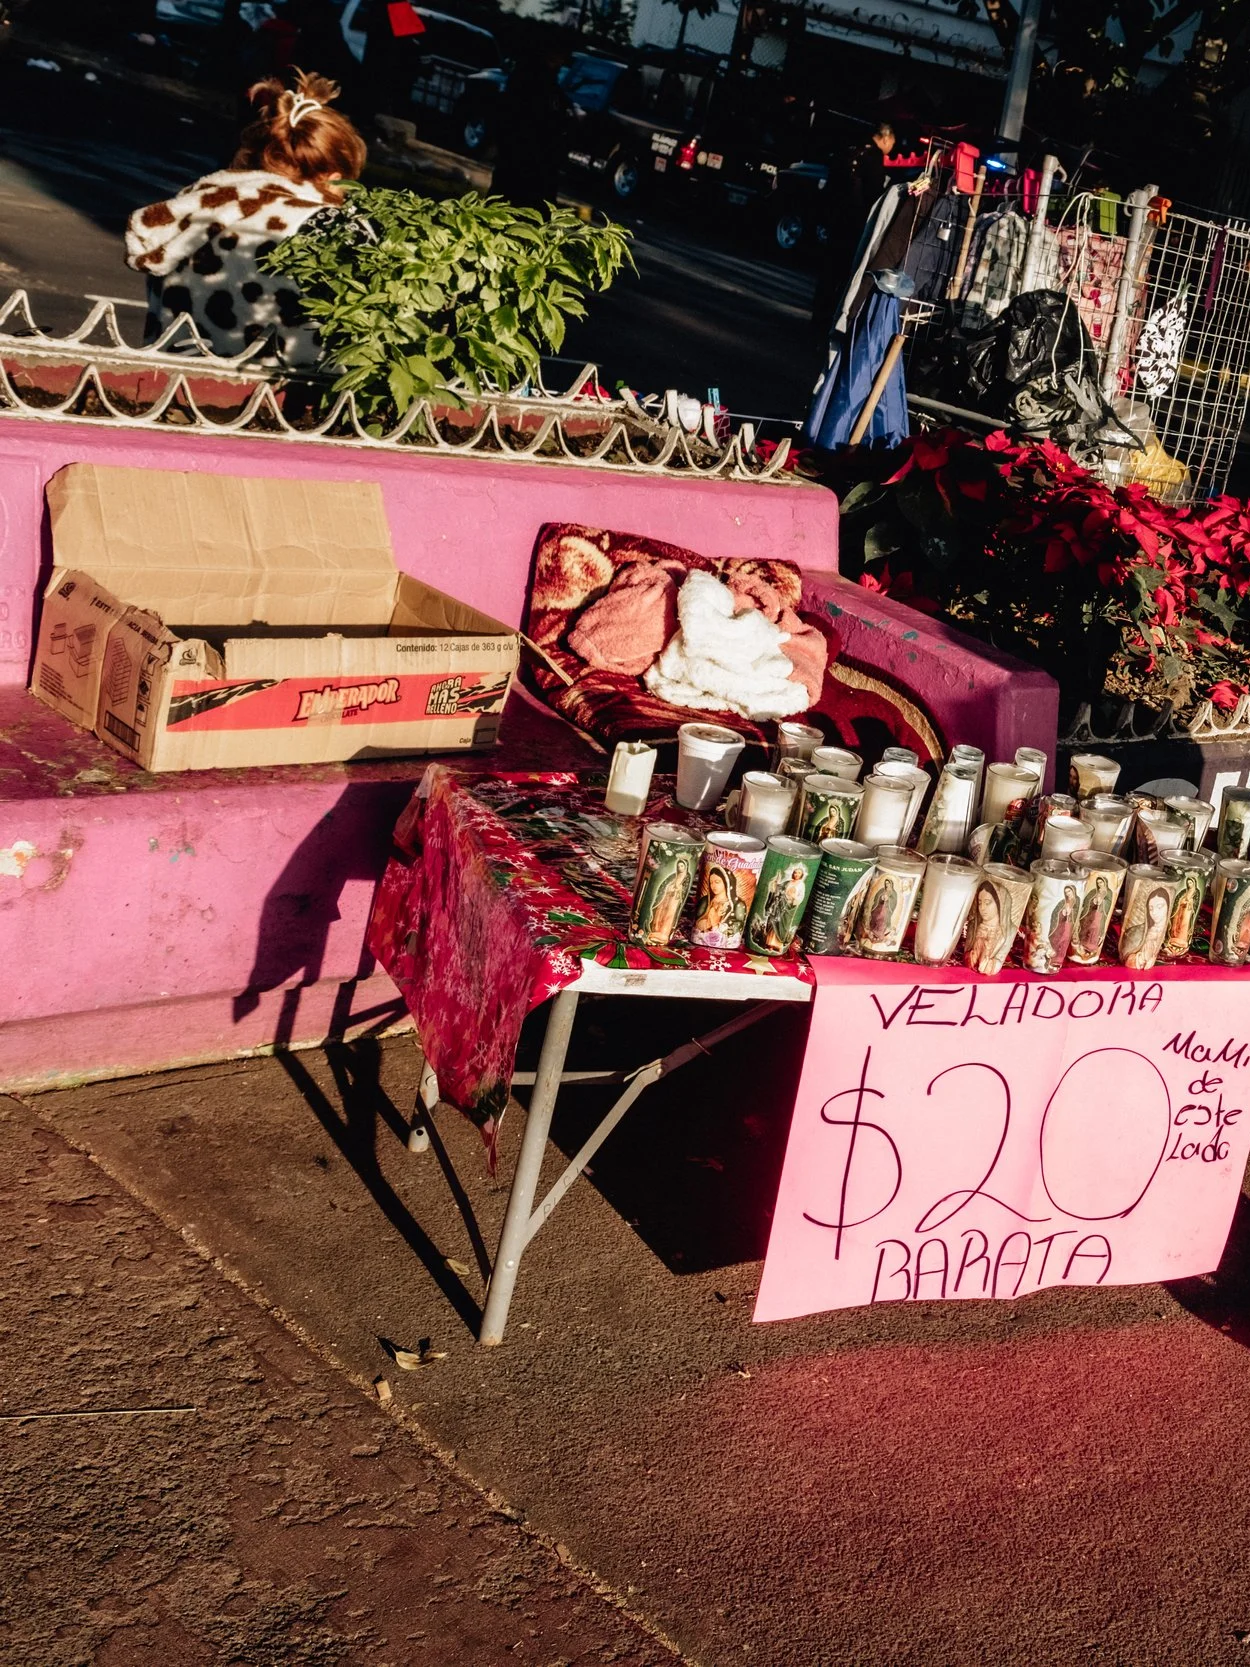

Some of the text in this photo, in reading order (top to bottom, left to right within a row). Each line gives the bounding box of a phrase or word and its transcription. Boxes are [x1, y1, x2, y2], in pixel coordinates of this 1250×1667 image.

[126, 620, 141, 634] ACIA
[396, 642, 514, 653] Contenido: 12 Cajas de 363 g c/u
[431, 676, 462, 693] AHORA
[425, 702, 458, 715] RELLENO
[870, 981, 1164, 1030] VELADORA
[1187, 1070, 1224, 1095] de
[802, 1045, 1172, 1261] $20
[870, 1229, 1112, 1304] BARATA
